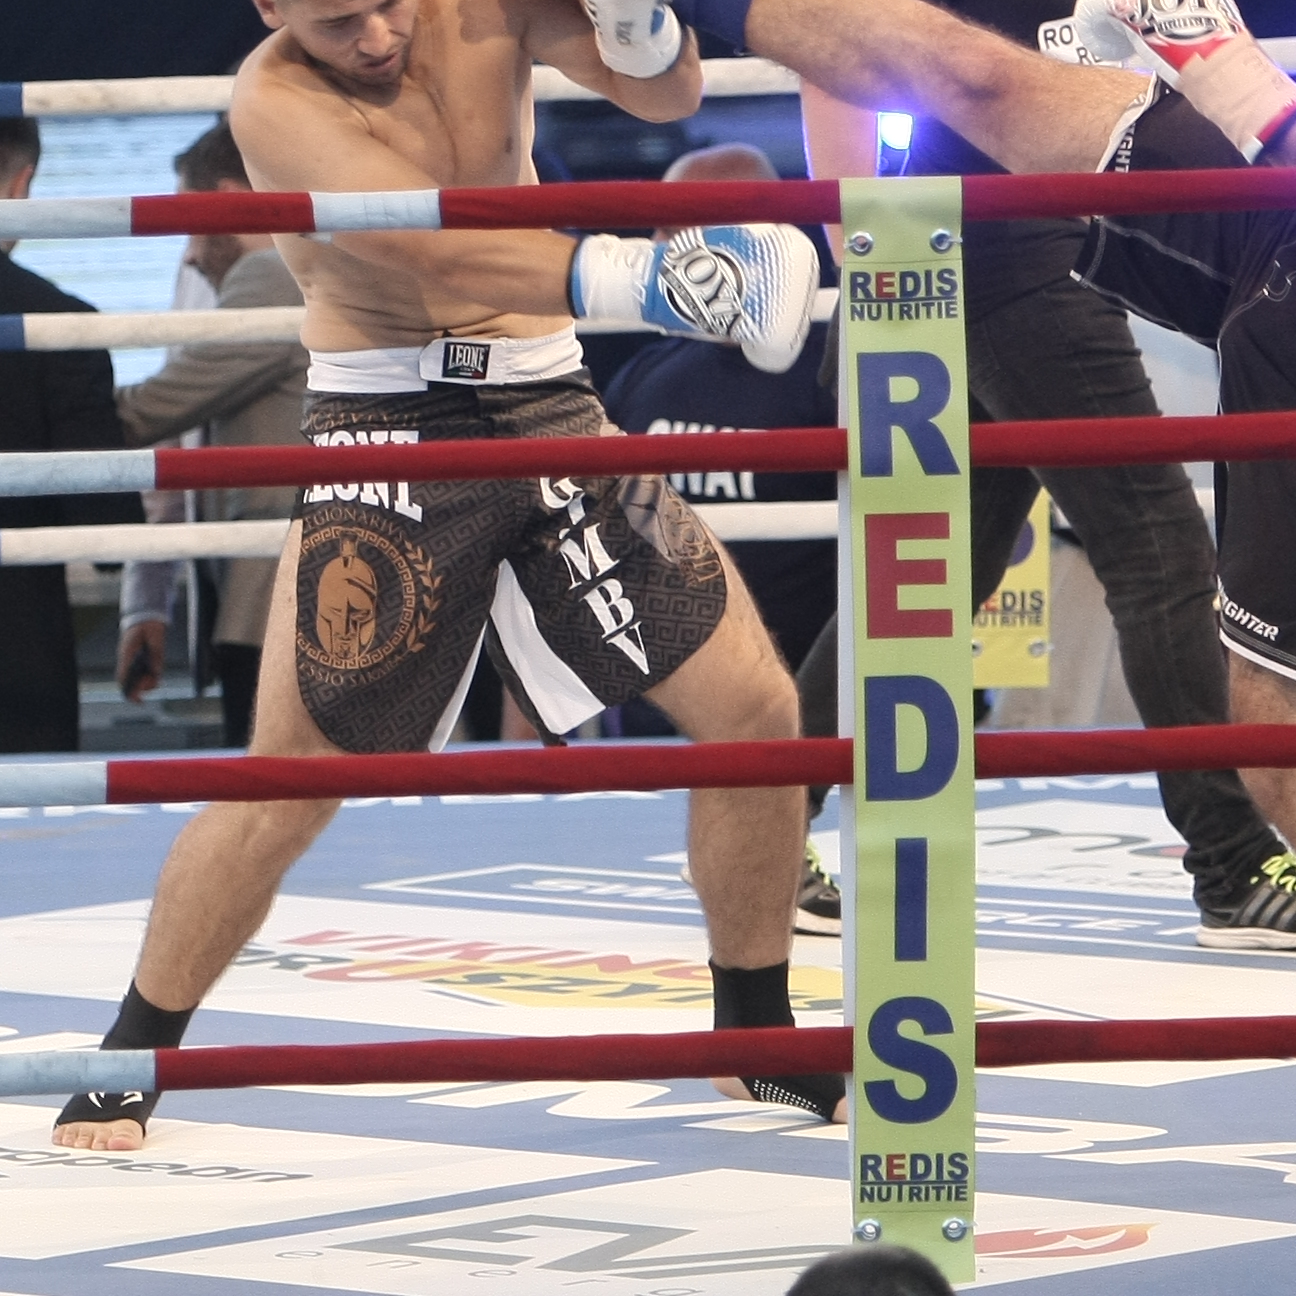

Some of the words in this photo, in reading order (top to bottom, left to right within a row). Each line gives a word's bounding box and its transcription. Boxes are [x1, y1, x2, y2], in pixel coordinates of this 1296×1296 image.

[851, 268, 958, 300] REDIS
[850, 298, 958, 323] NUTRITIE
[448, 344, 486, 372] LEONE
[303, 507, 404, 543] EGIONARIVS
[856, 350, 960, 1125] REDIS
[860, 1153, 969, 1181] REDIS
[860, 1180, 968, 1204] NUTRITIE
